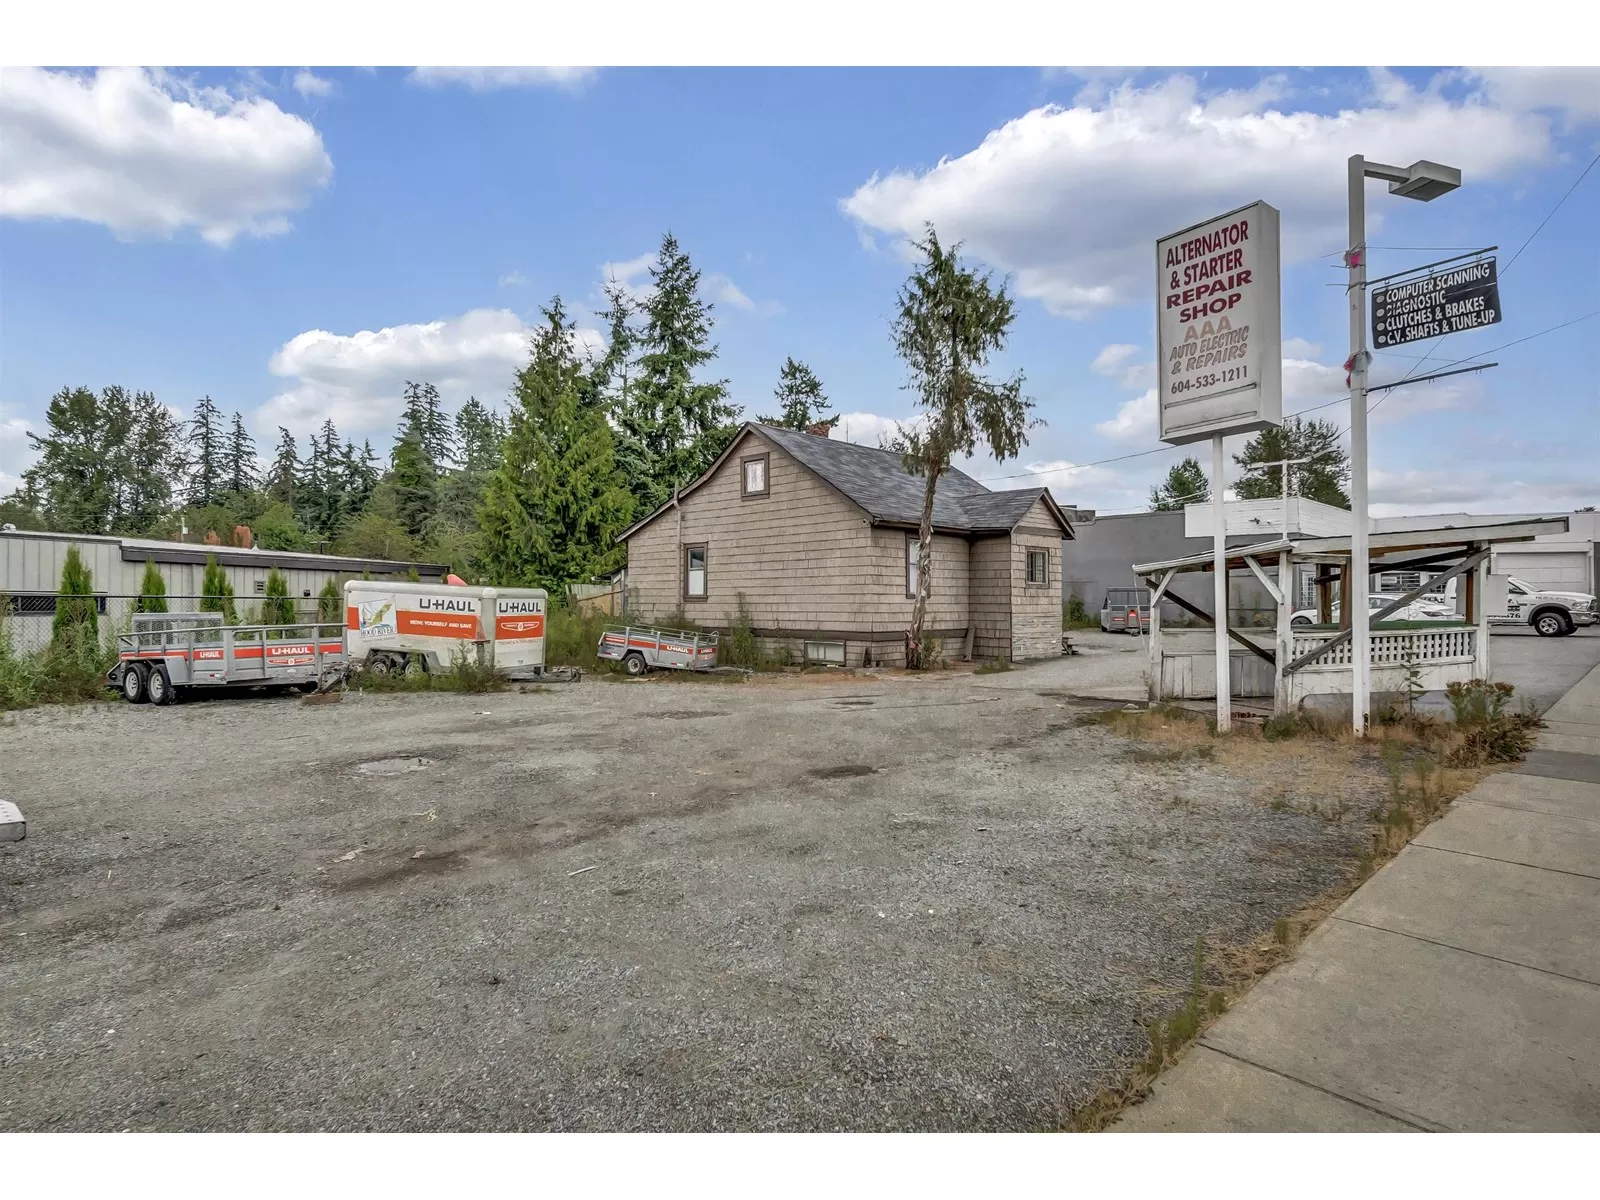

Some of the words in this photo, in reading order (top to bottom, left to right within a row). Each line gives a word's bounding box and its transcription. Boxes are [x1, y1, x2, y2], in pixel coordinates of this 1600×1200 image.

[1166, 220, 1249, 268] ALTERNATOR
[1170, 270, 1181, 290] &
[1184, 248, 1243, 286] STARTER
[1386, 279, 1434, 303] COMPUTER
[1436, 263, 1490, 290] SCANNING
[1166, 269, 1253, 310] REPAIR
[1386, 290, 1447, 317] DIAGNOSTIC
[1179, 292, 1242, 323] SHOP
[1386, 308, 1433, 331] CLUTCHES
[1435, 306, 1443, 320] &
[1445, 296, 1485, 318] BRAKES
[1183, 315, 1232, 343] AAA
[1387, 328, 1405, 345] C.V.
[1406, 321, 1440, 341] SHAFTS
[1442, 319, 1450, 333] &
[1451, 309, 1496, 331] TUNE-UP
[1169, 341, 1198, 362] AUTO
[1199, 325, 1249, 354] ELECTRIC
[1171, 360, 1182, 375] &
[1186, 342, 1248, 372] REPAIRS
[1171, 365, 1248, 395] 604-533-1211
[419, 598, 476, 612] U-HAUL
[499, 602, 542, 613] U-HAUL
[199, 650, 221, 658] U-HAUL
[272, 647, 311, 655] U-HAUL
[666, 645, 689, 654] U-HAUL
